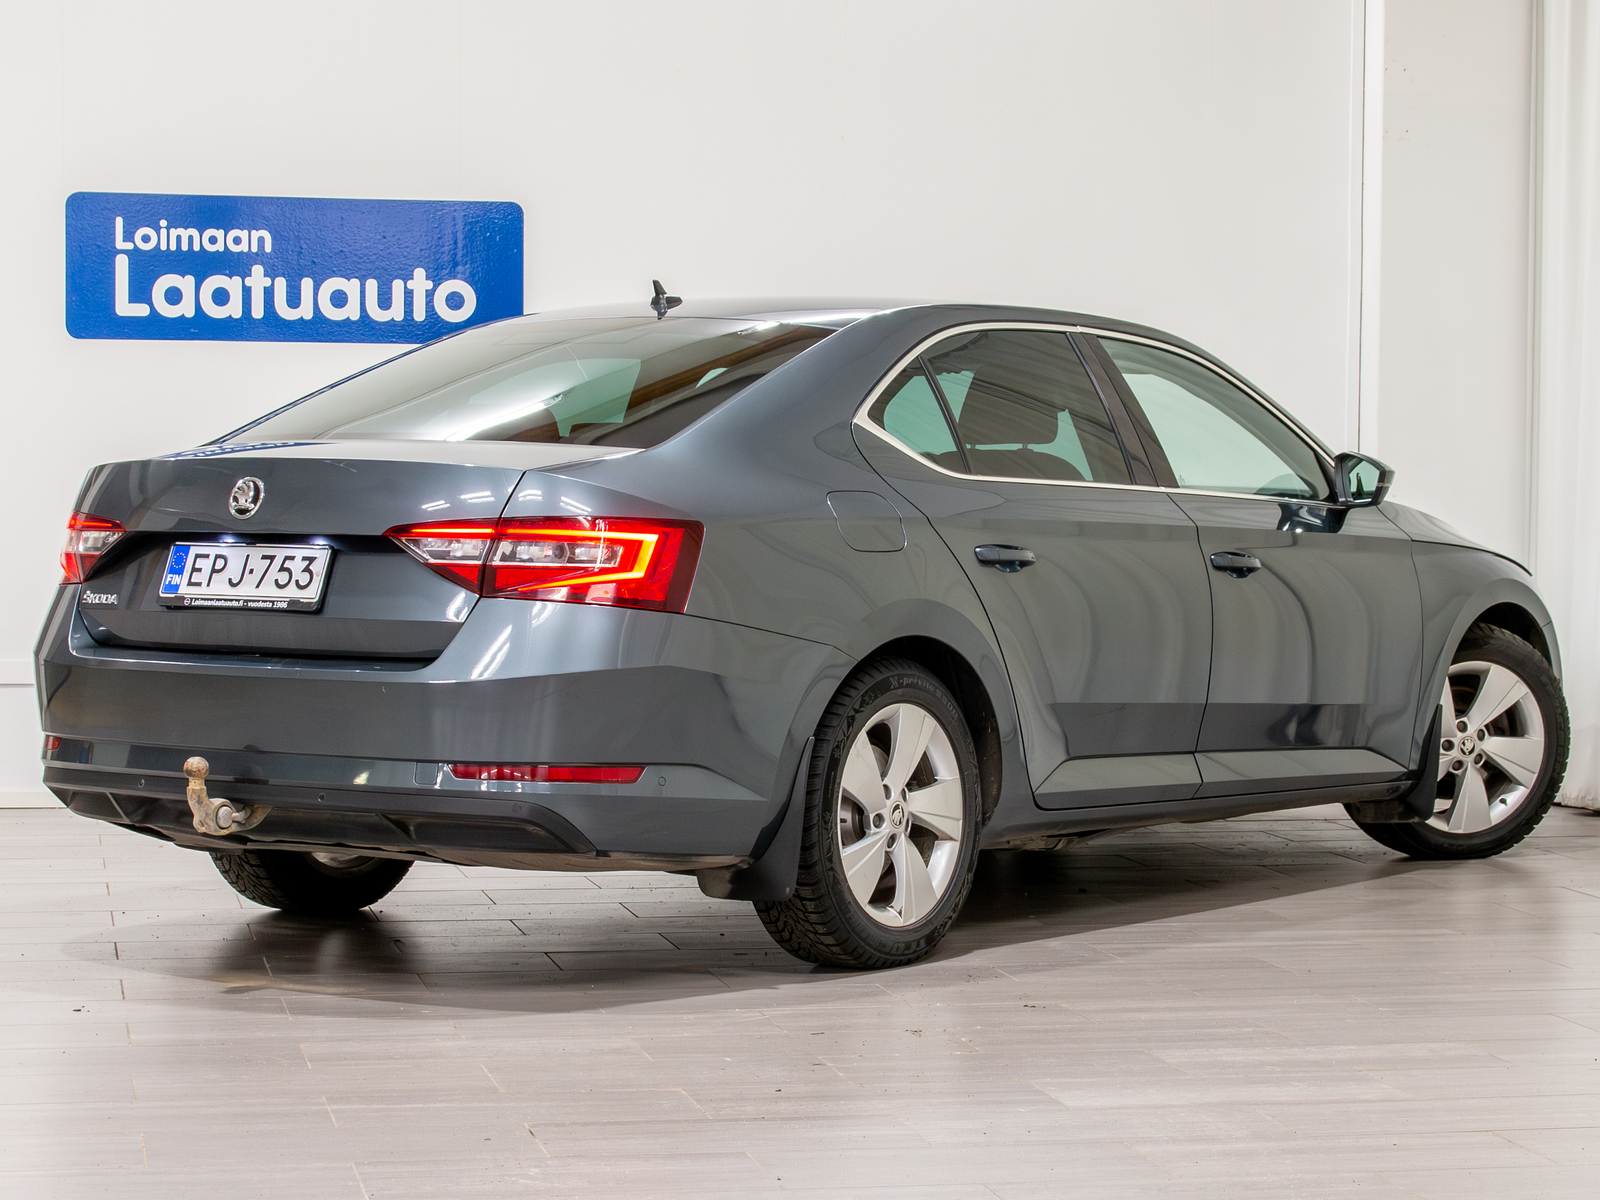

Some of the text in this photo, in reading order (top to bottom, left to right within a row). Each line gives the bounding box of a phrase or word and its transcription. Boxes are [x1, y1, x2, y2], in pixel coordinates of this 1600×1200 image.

[115, 216, 272, 252] Loimaan
[115, 253, 477, 322] Laatuauto
[165, 573, 182, 586] FIN
[187, 553, 318, 590] EPJ-753
[82, 590, 118, 605] ŠKODA
[191, 598, 244, 607] Loimaanlaatuauto.fi
[247, 600, 273, 608] vuodesta
[273, 601, 288, 609] 1986
